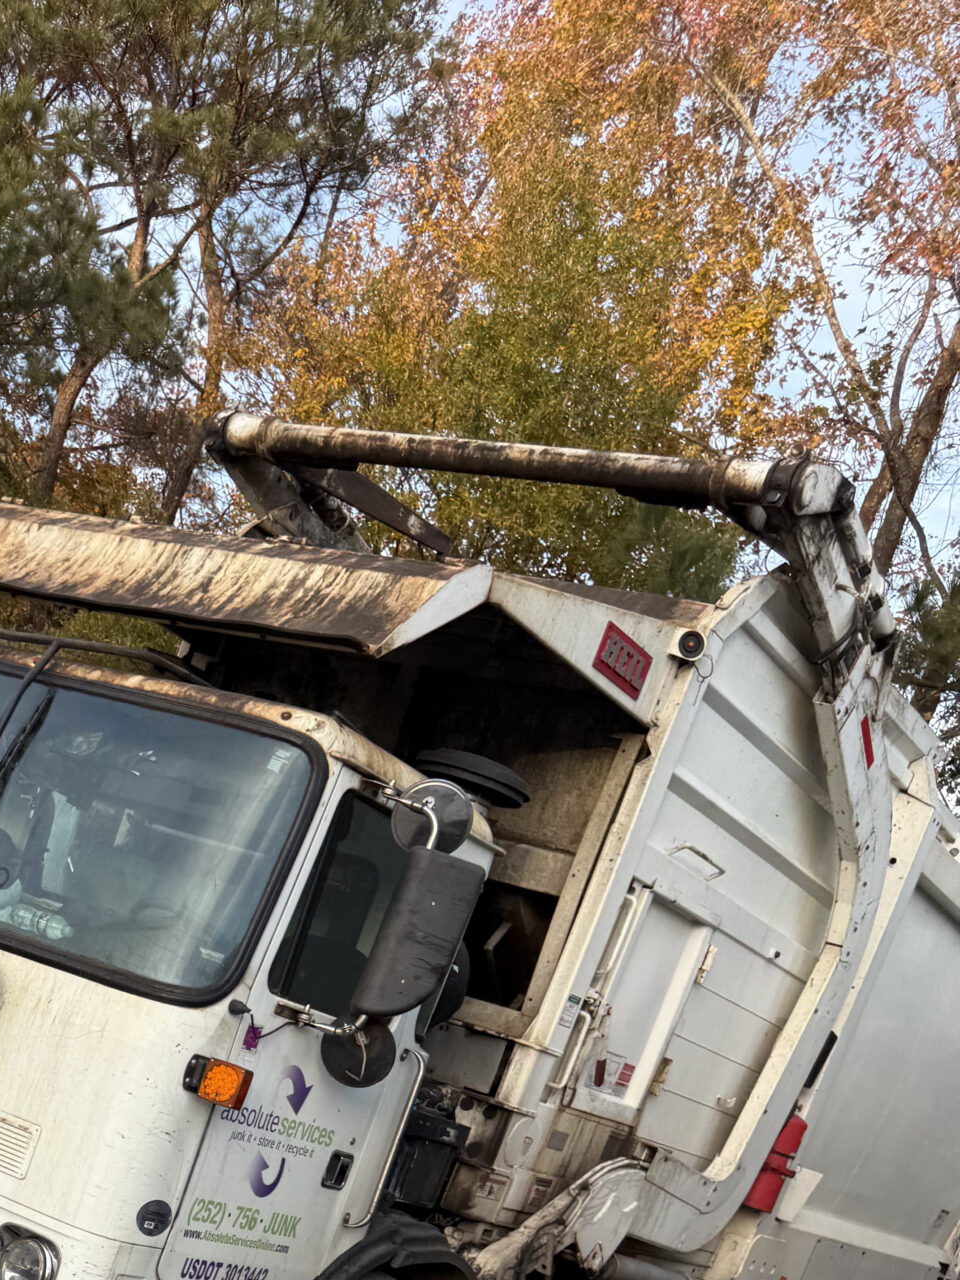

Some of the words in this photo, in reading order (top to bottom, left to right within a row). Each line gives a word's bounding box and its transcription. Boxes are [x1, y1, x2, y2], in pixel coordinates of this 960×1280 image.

[602, 632, 645, 690] HEIL
[229, 1130, 246, 1142] junk
[257, 1136, 275, 1149] store
[285, 1143, 309, 1158] recycle
[187, 1198, 227, 1230] (252)
[232, 1205, 261, 1231] 756
[263, 1212, 302, 1238] JUNK
